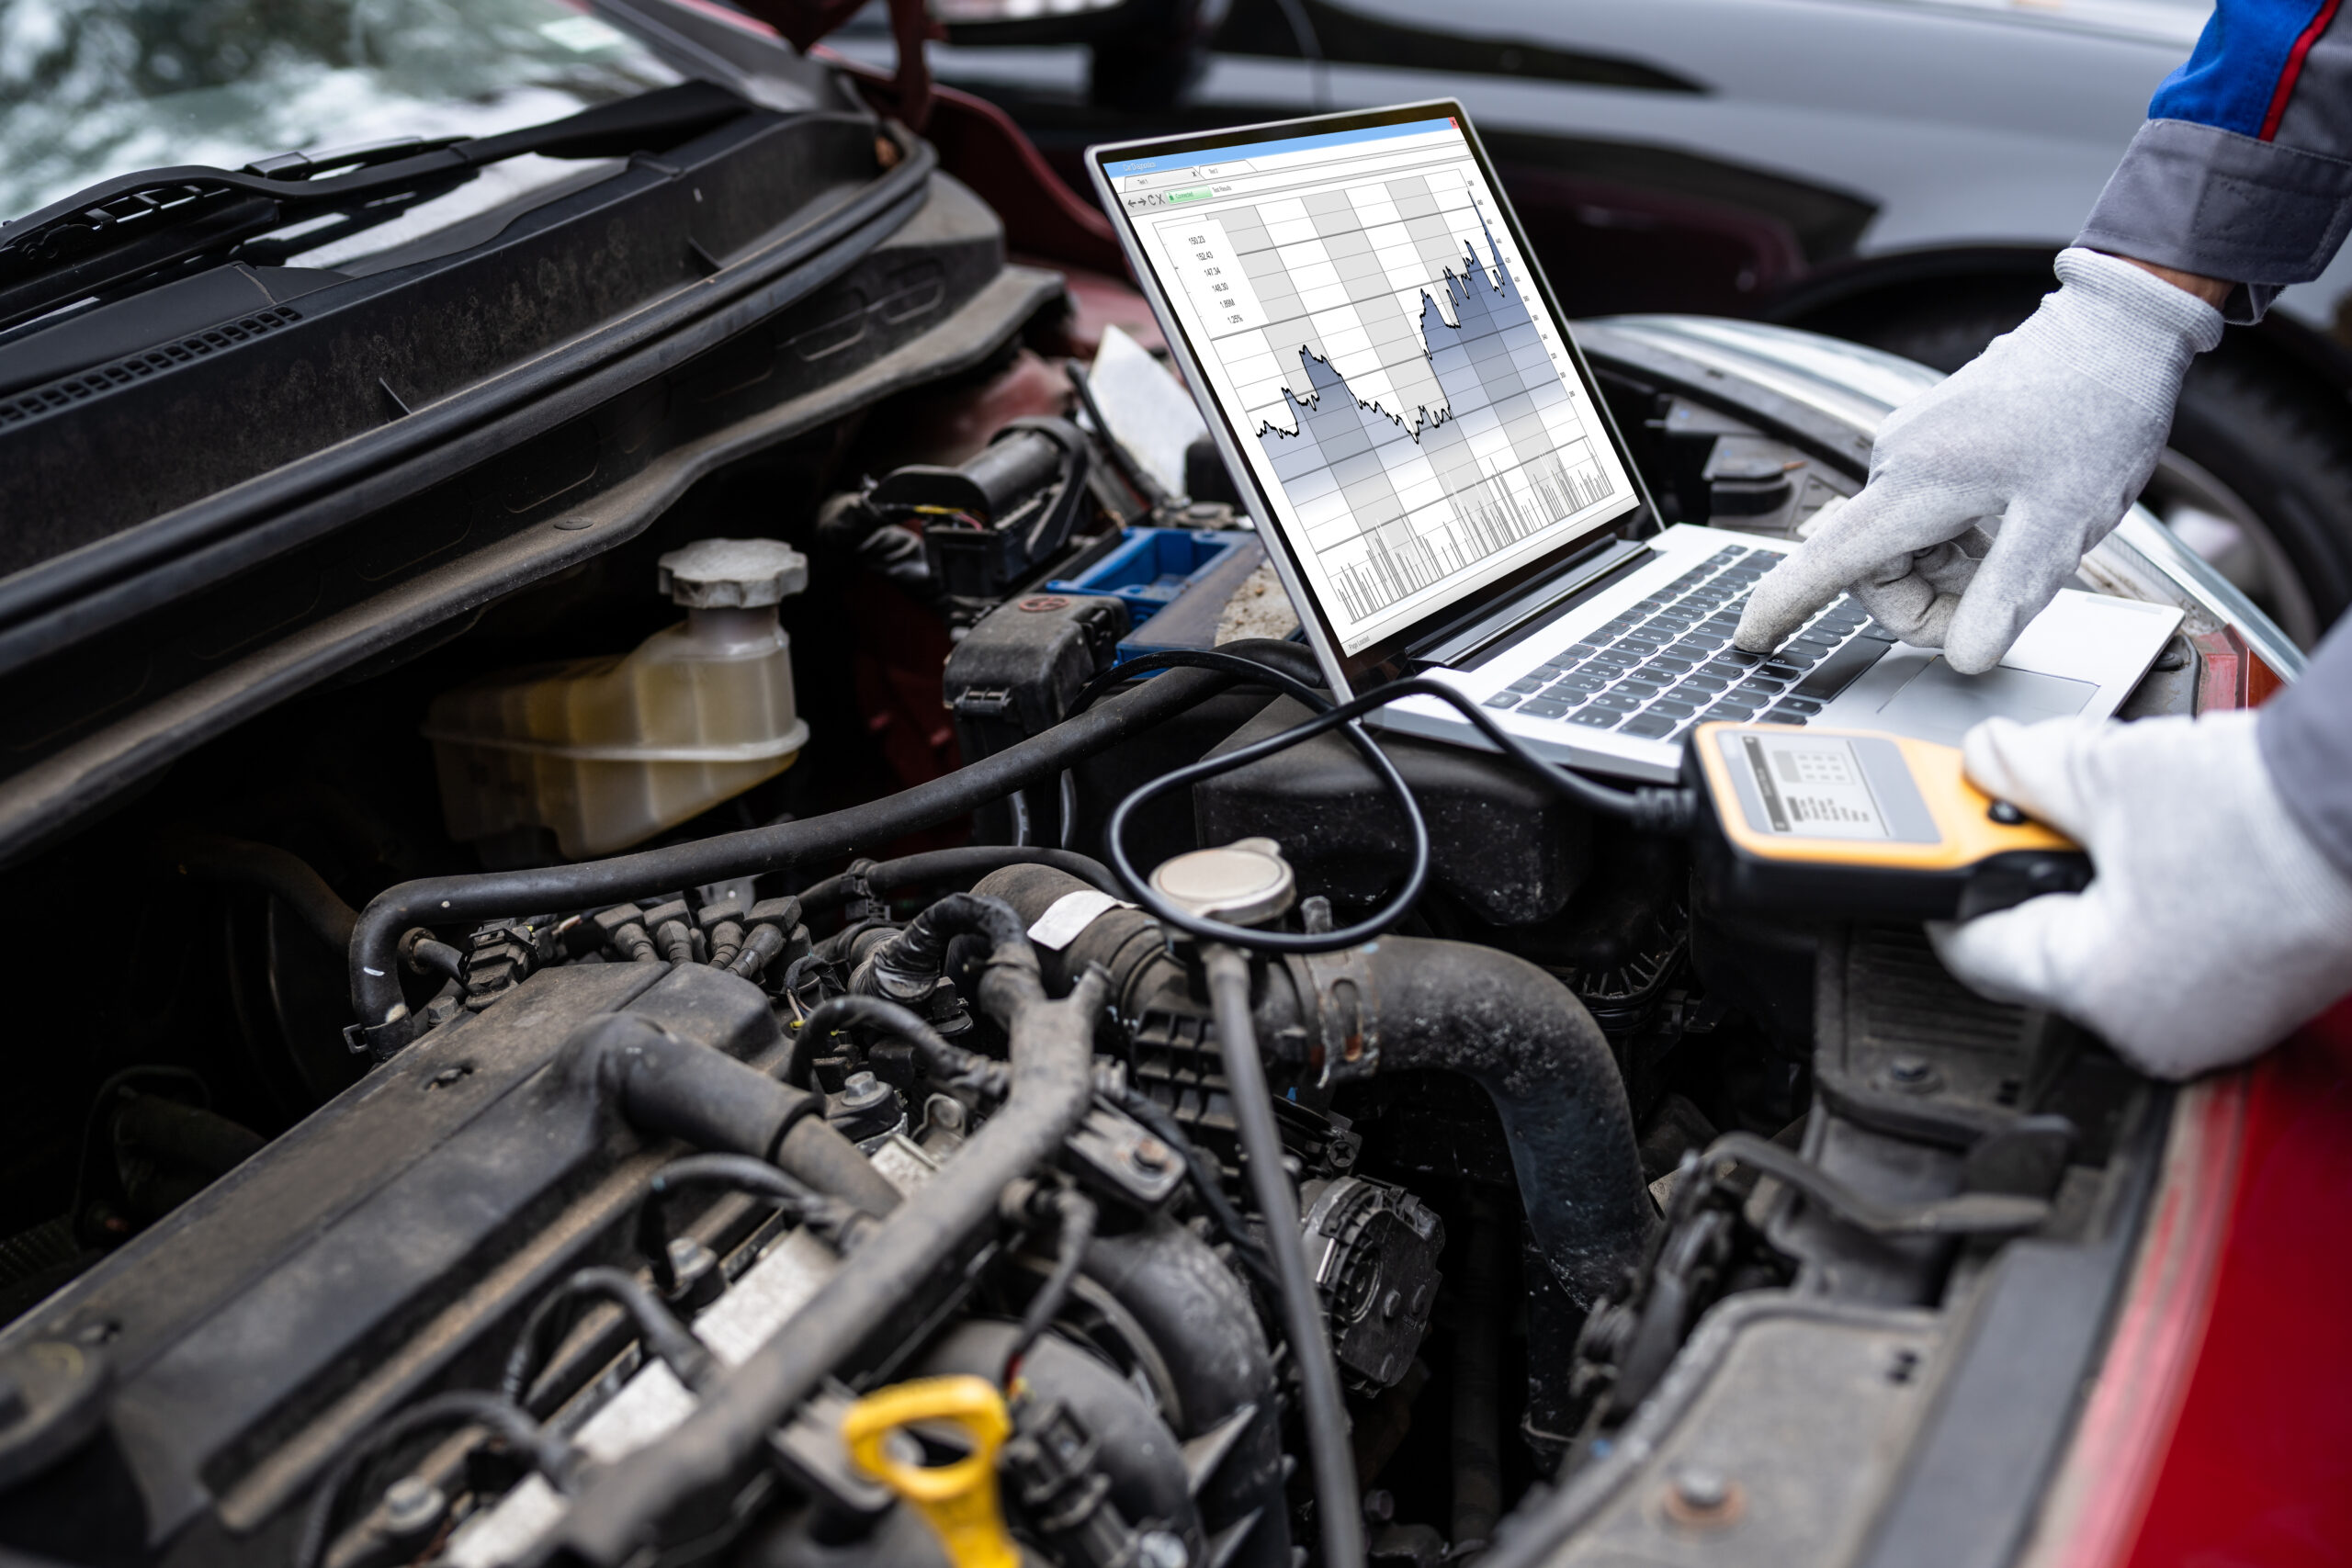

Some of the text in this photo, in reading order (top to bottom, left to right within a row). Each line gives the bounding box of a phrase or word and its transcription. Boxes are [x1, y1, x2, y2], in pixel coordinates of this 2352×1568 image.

[1188, 235, 1206, 245] 150.23
[1196, 251, 1213, 261] 152.43
[1204, 267, 1221, 276] 147.34
[1212, 282, 1229, 292] 148.30
[1220, 299, 1235, 308] 1.89M
[1227, 314, 1244, 324] 1.25%
